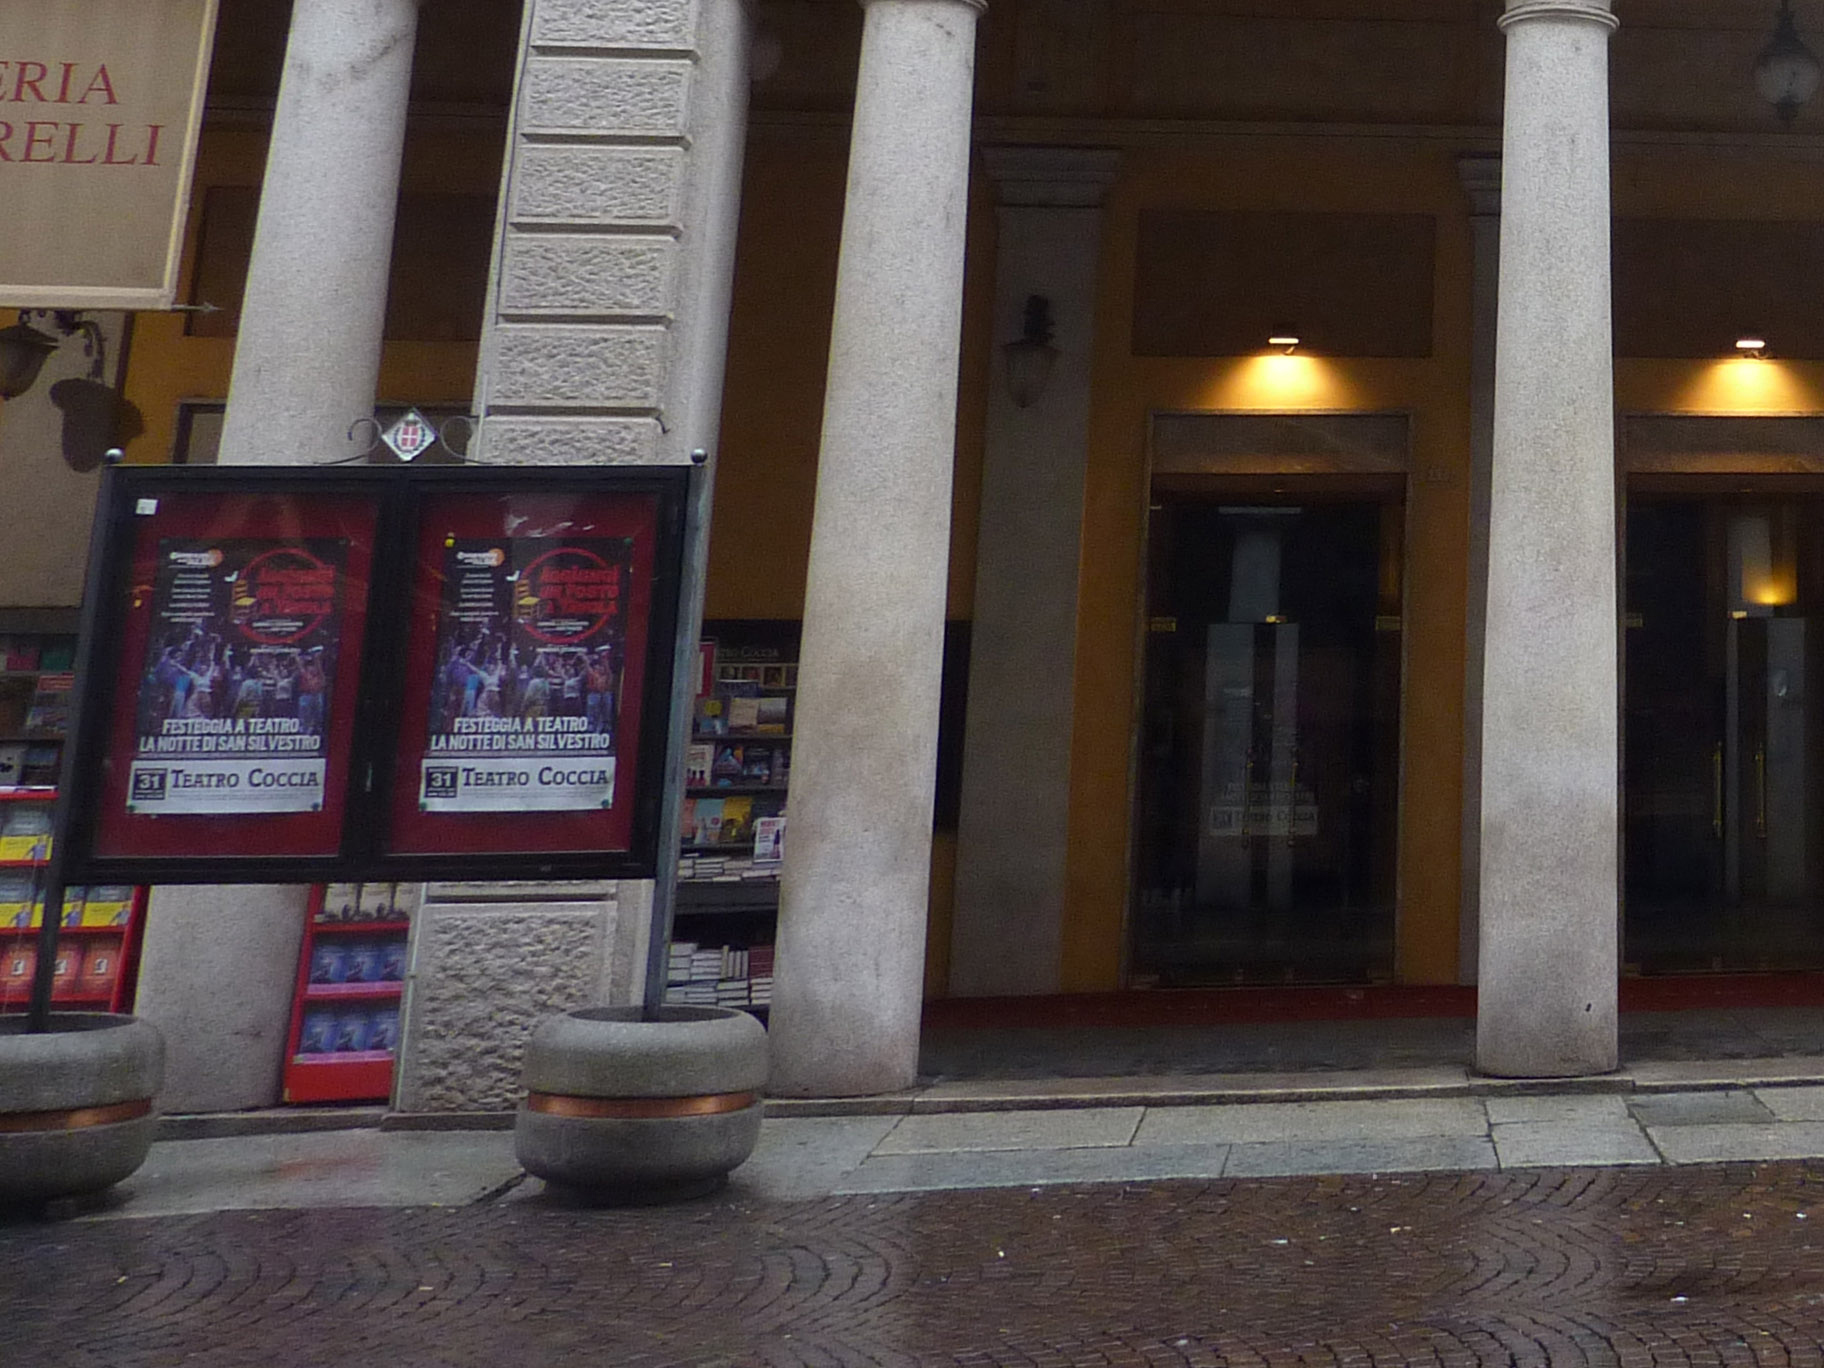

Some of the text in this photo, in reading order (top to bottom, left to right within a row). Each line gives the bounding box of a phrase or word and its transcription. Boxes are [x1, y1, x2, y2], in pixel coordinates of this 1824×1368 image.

[235, 718, 245, 733] A
[250, 717, 299, 733] TEATRO
[523, 717, 533, 732] A
[537, 716, 587, 731] TEATRO
[139, 736, 155, 752] LA
[157, 736, 201, 752] NOTTE
[202, 735, 215, 751] DI
[218, 735, 246, 751] SAN
[431, 735, 447, 750] LA
[448, 735, 491, 750] NOTTE
[492, 734, 505, 749] DI
[508, 734, 535, 749] SAN
[139, 774, 161, 790] 31
[171, 768, 319, 788] TEATRO COCCIA
[431, 773, 451, 787] 31
[462, 767, 608, 786] TEATRO COCCIA
